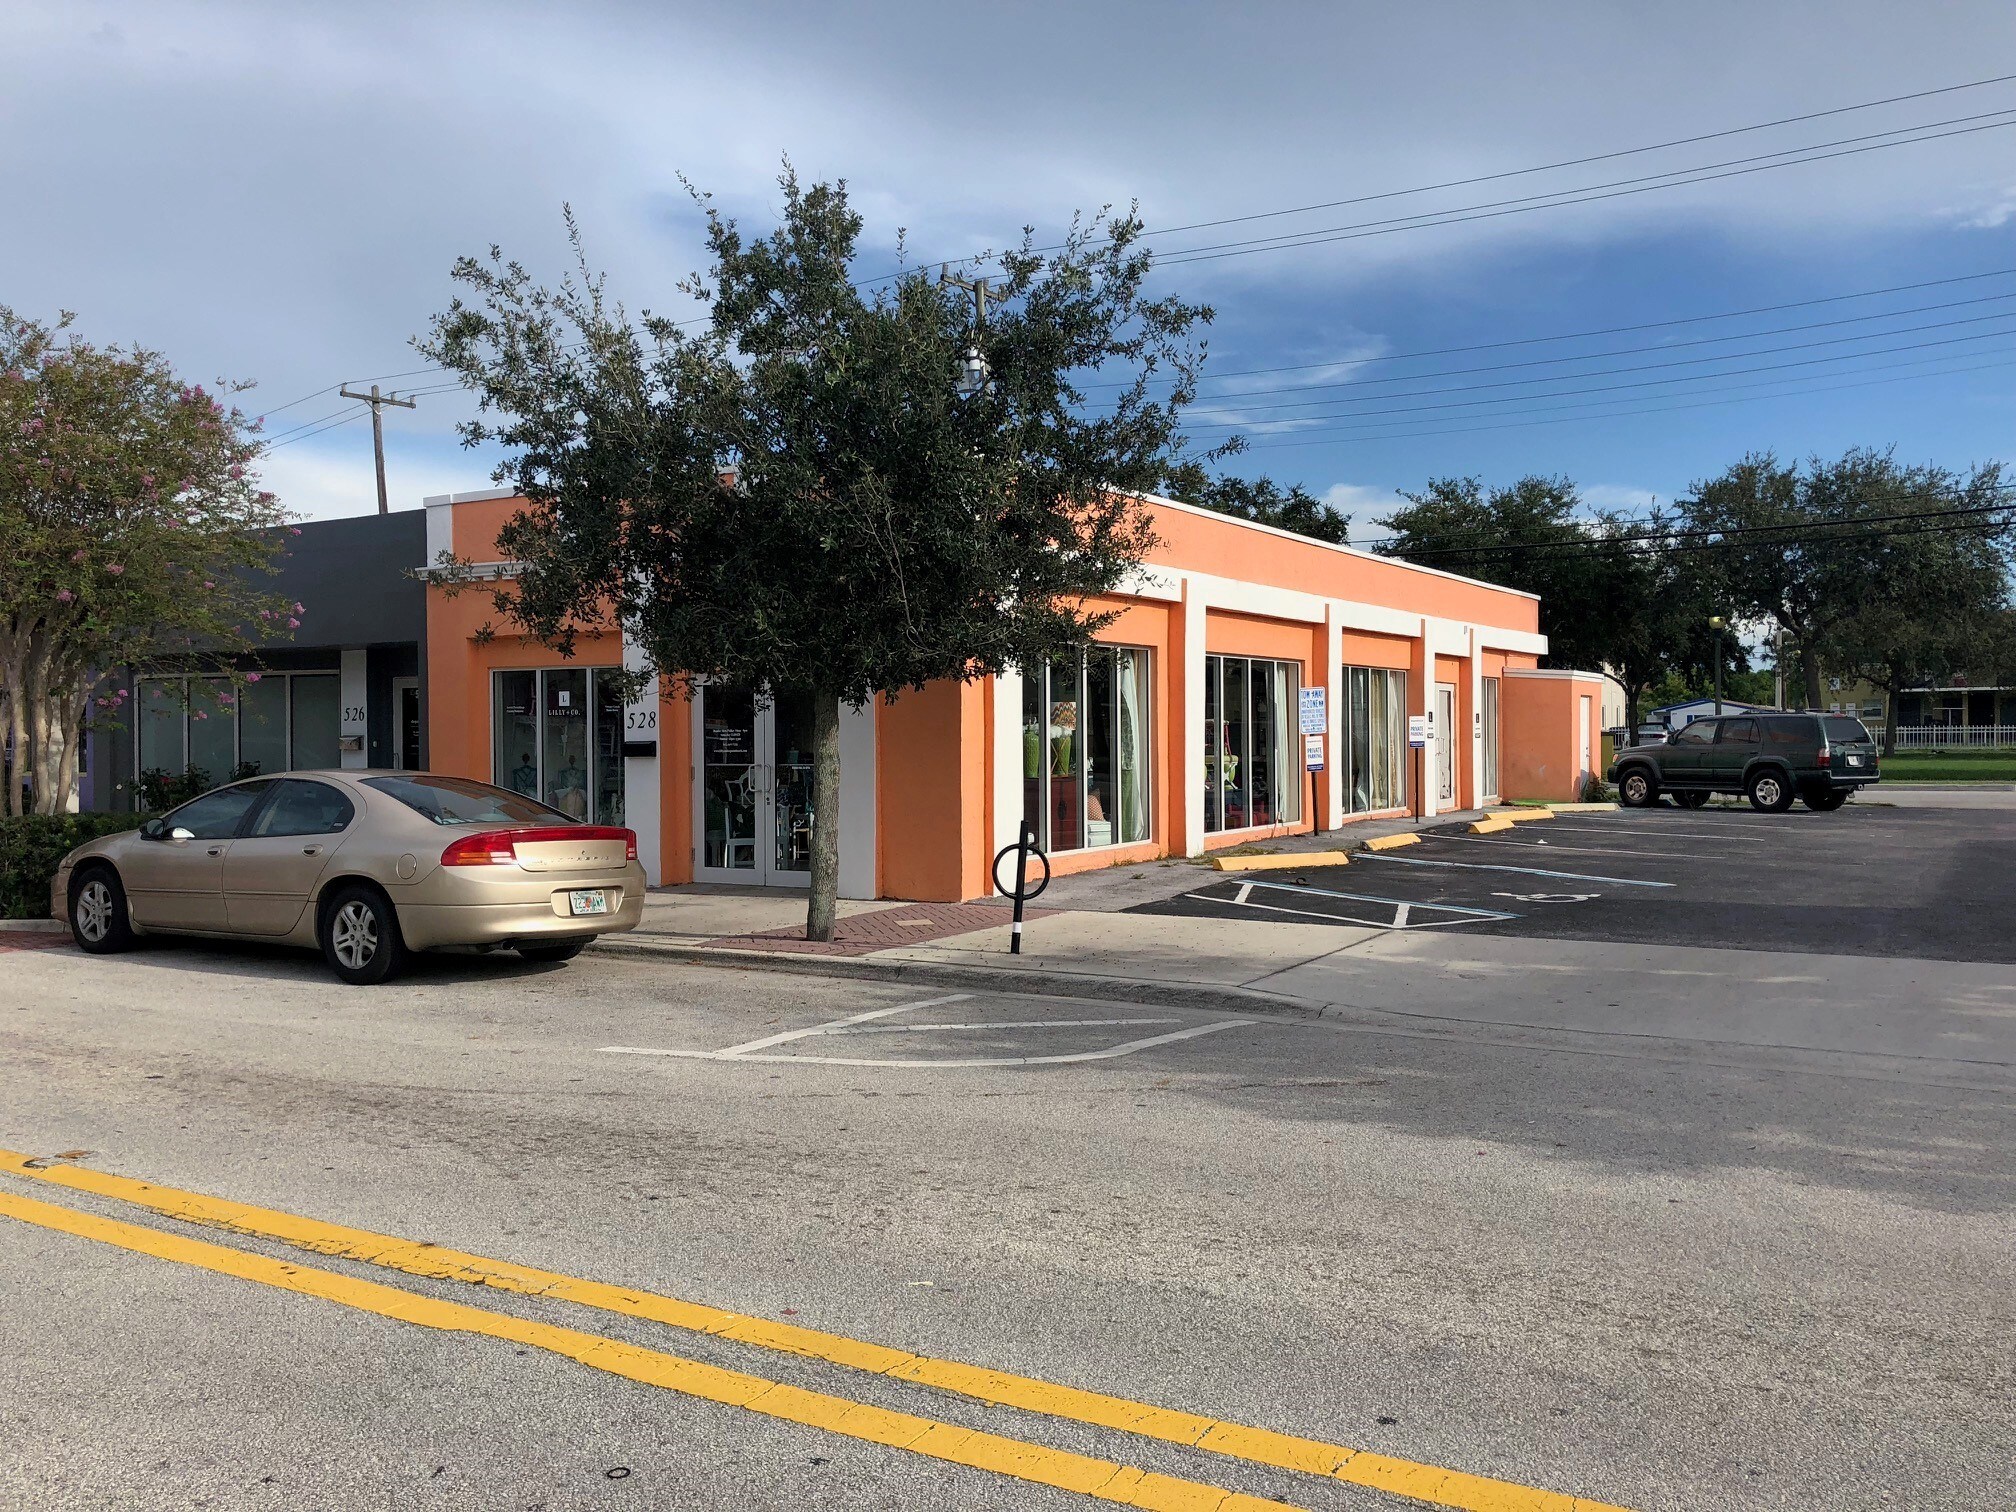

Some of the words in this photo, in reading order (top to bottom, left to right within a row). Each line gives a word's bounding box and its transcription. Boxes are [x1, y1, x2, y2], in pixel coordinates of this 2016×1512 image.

[1300, 690, 1310, 699] TOW
[1311, 690, 1323, 698] AWAY
[1306, 699, 1318, 709] ZONE
[344, 706, 365, 721] 526
[627, 711, 656, 729] 528
